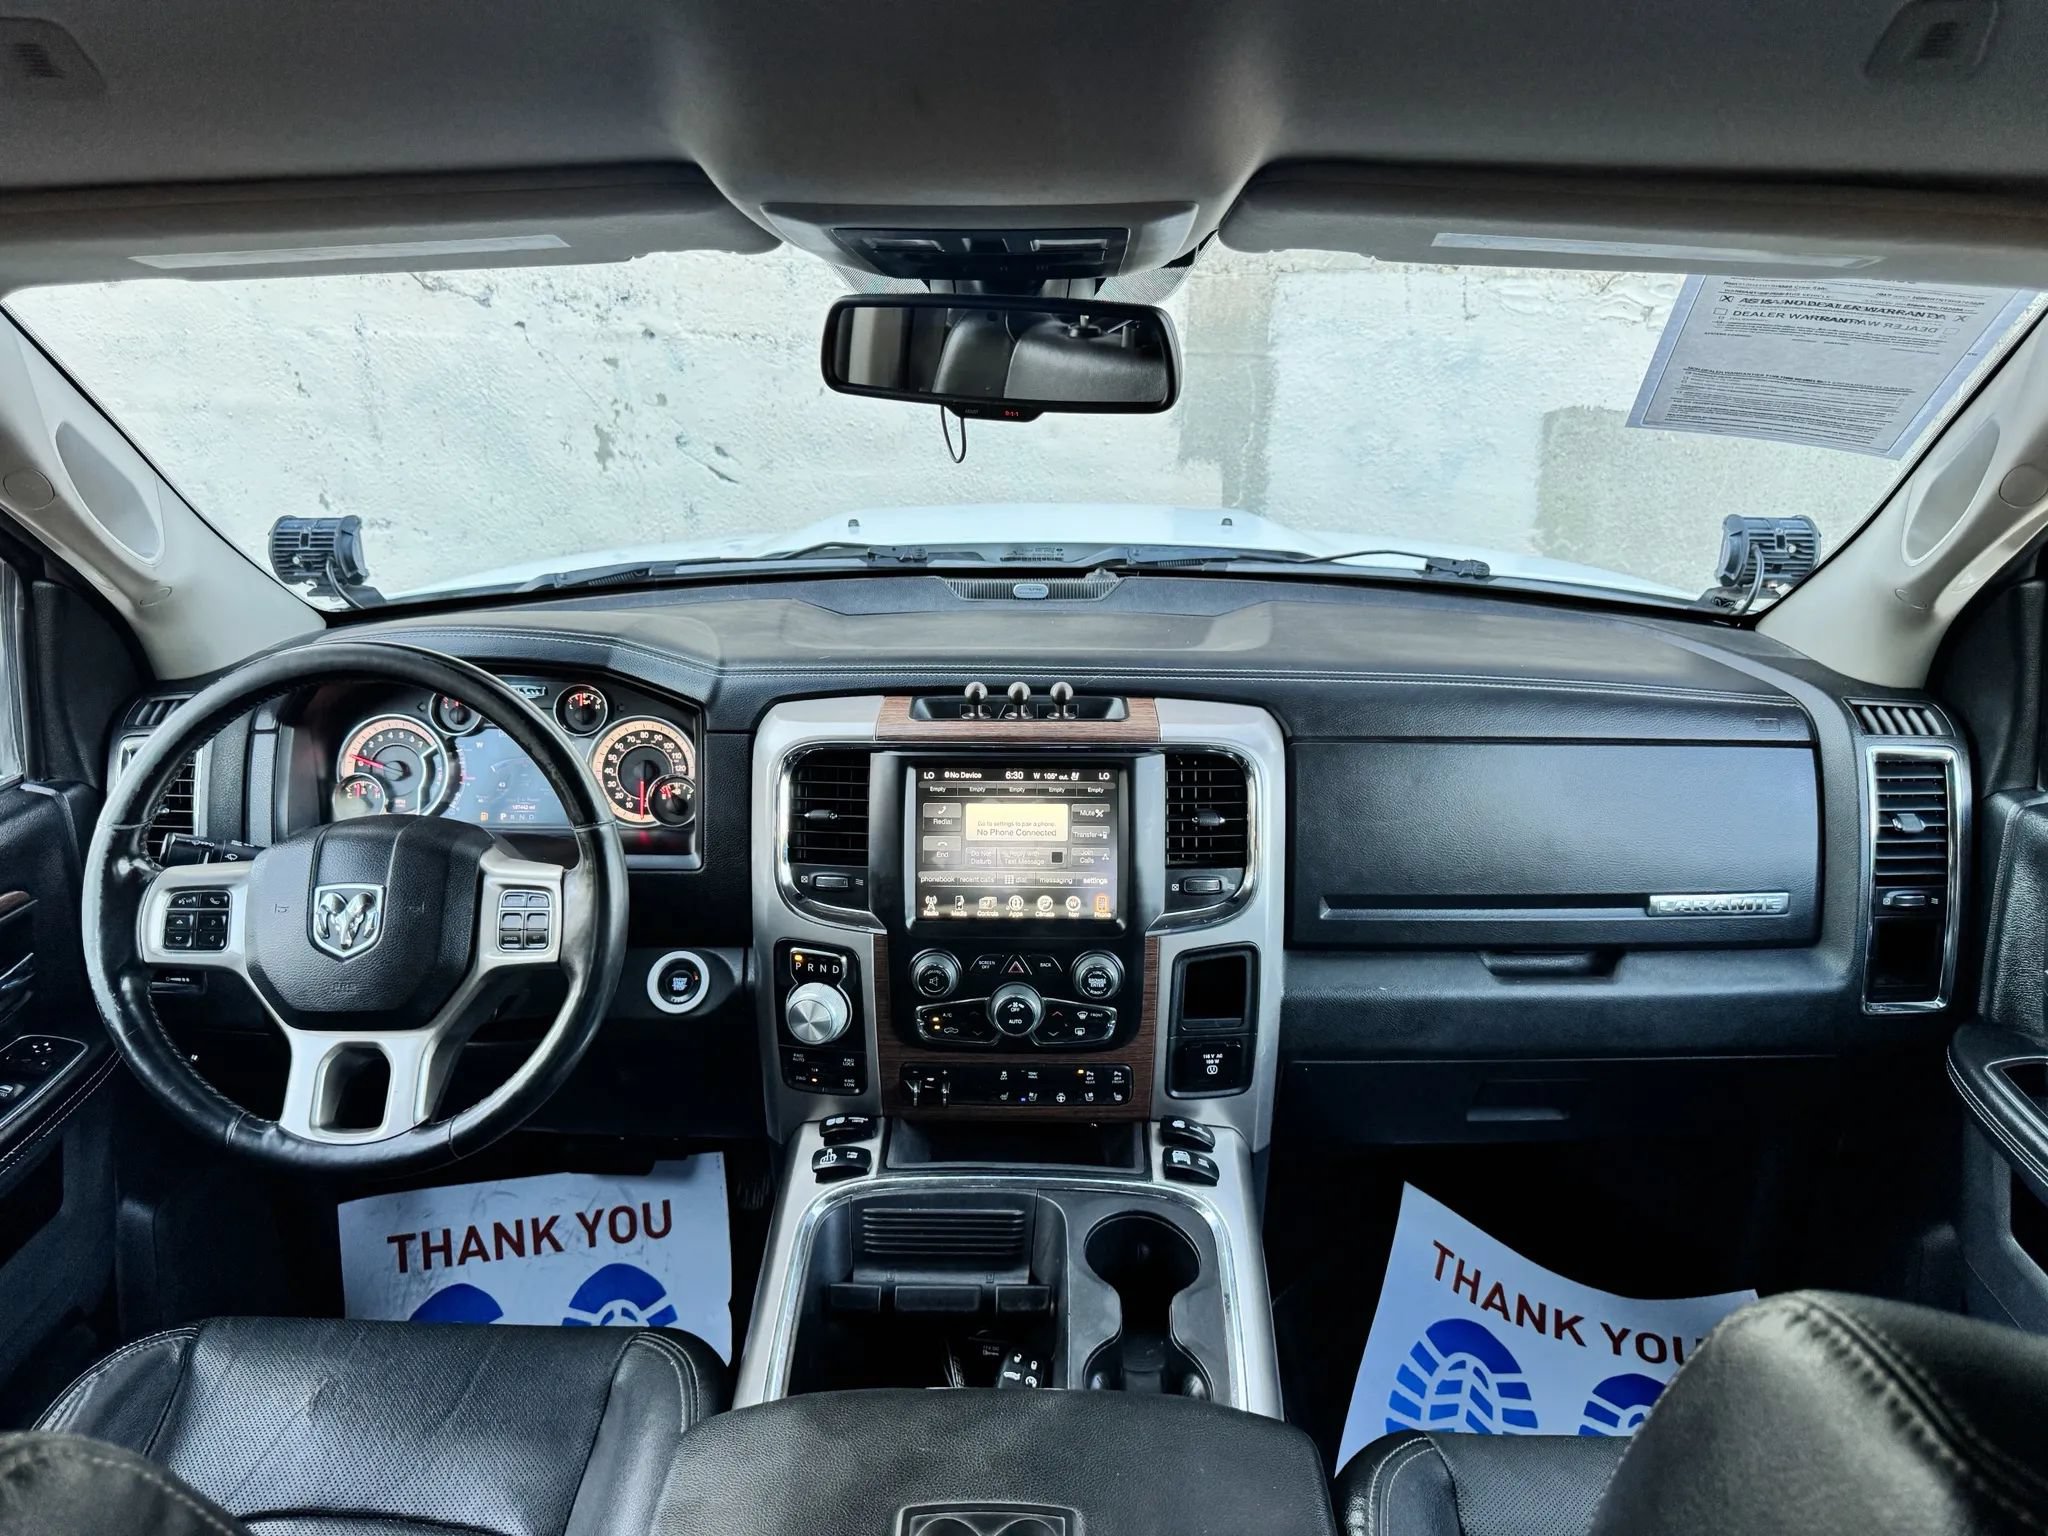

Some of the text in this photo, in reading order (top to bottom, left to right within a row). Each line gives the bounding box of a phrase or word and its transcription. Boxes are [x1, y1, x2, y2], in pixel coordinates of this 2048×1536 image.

[1733, 310, 1786, 318] DEALER
[626, 734, 636, 744] 70
[640, 731, 649, 740] 80
[654, 733, 662, 742] 90
[614, 742, 624, 750] 60
[664, 742, 674, 750] 100
[608, 754, 617, 762] 50
[672, 752, 682, 760] 110
[604, 766, 614, 775] 40
[675, 764, 686, 773] 120
[1005, 770, 1024, 780] 6:30
[608, 780, 616, 788] 30
[614, 790, 624, 800] 20
[626, 802, 633, 810] 10
[500, 812, 507, 820] P
[1656, 897, 1783, 913] LARAMIE
[796, 962, 840, 974] P R N D
[387, 1198, 674, 1274] THANK YOU
[1432, 1239, 1700, 1366] THANK YOU
